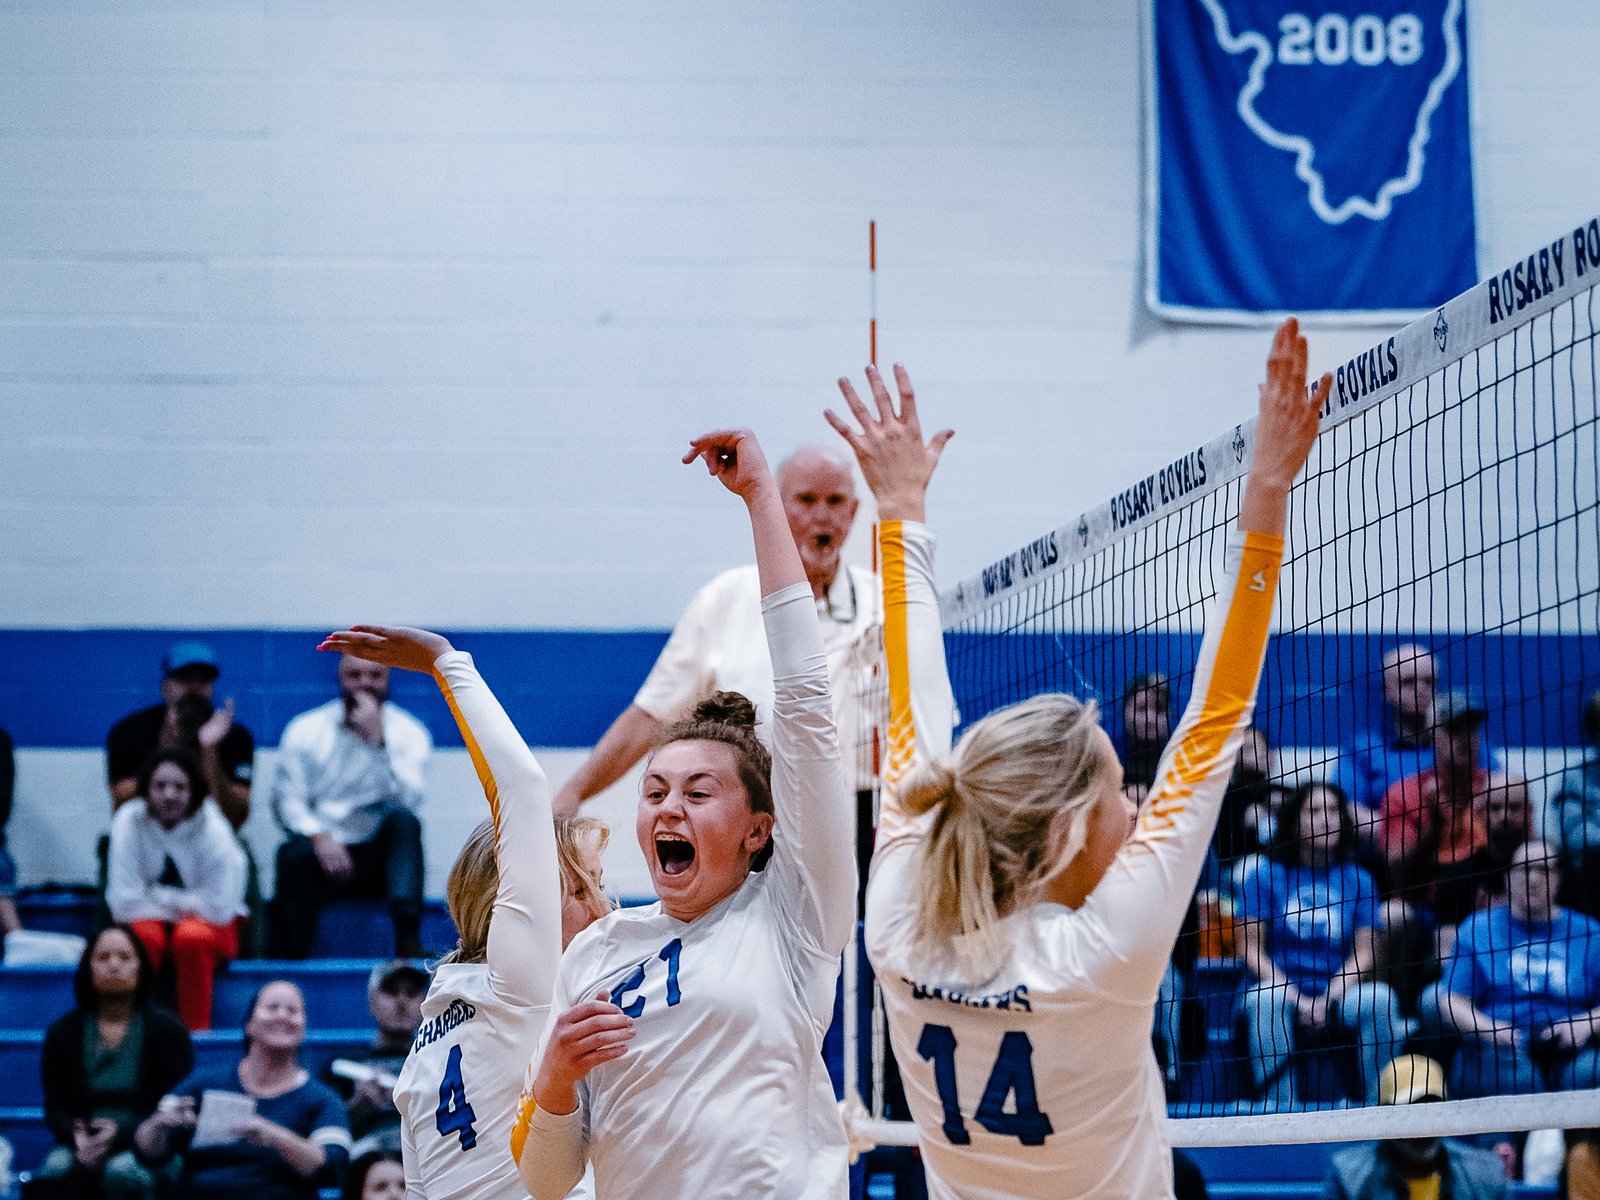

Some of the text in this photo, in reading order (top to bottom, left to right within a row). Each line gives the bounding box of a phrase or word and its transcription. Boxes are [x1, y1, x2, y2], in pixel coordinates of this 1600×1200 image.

[1278, 12, 1424, 66] 2008
[1488, 237, 1565, 325] ROSARY
[1336, 336, 1398, 408] ROYALS
[1110, 447, 1207, 533] ROSARY ROYALS
[435, 1043, 477, 1152] 4
[916, 1023, 1055, 1146] 14
